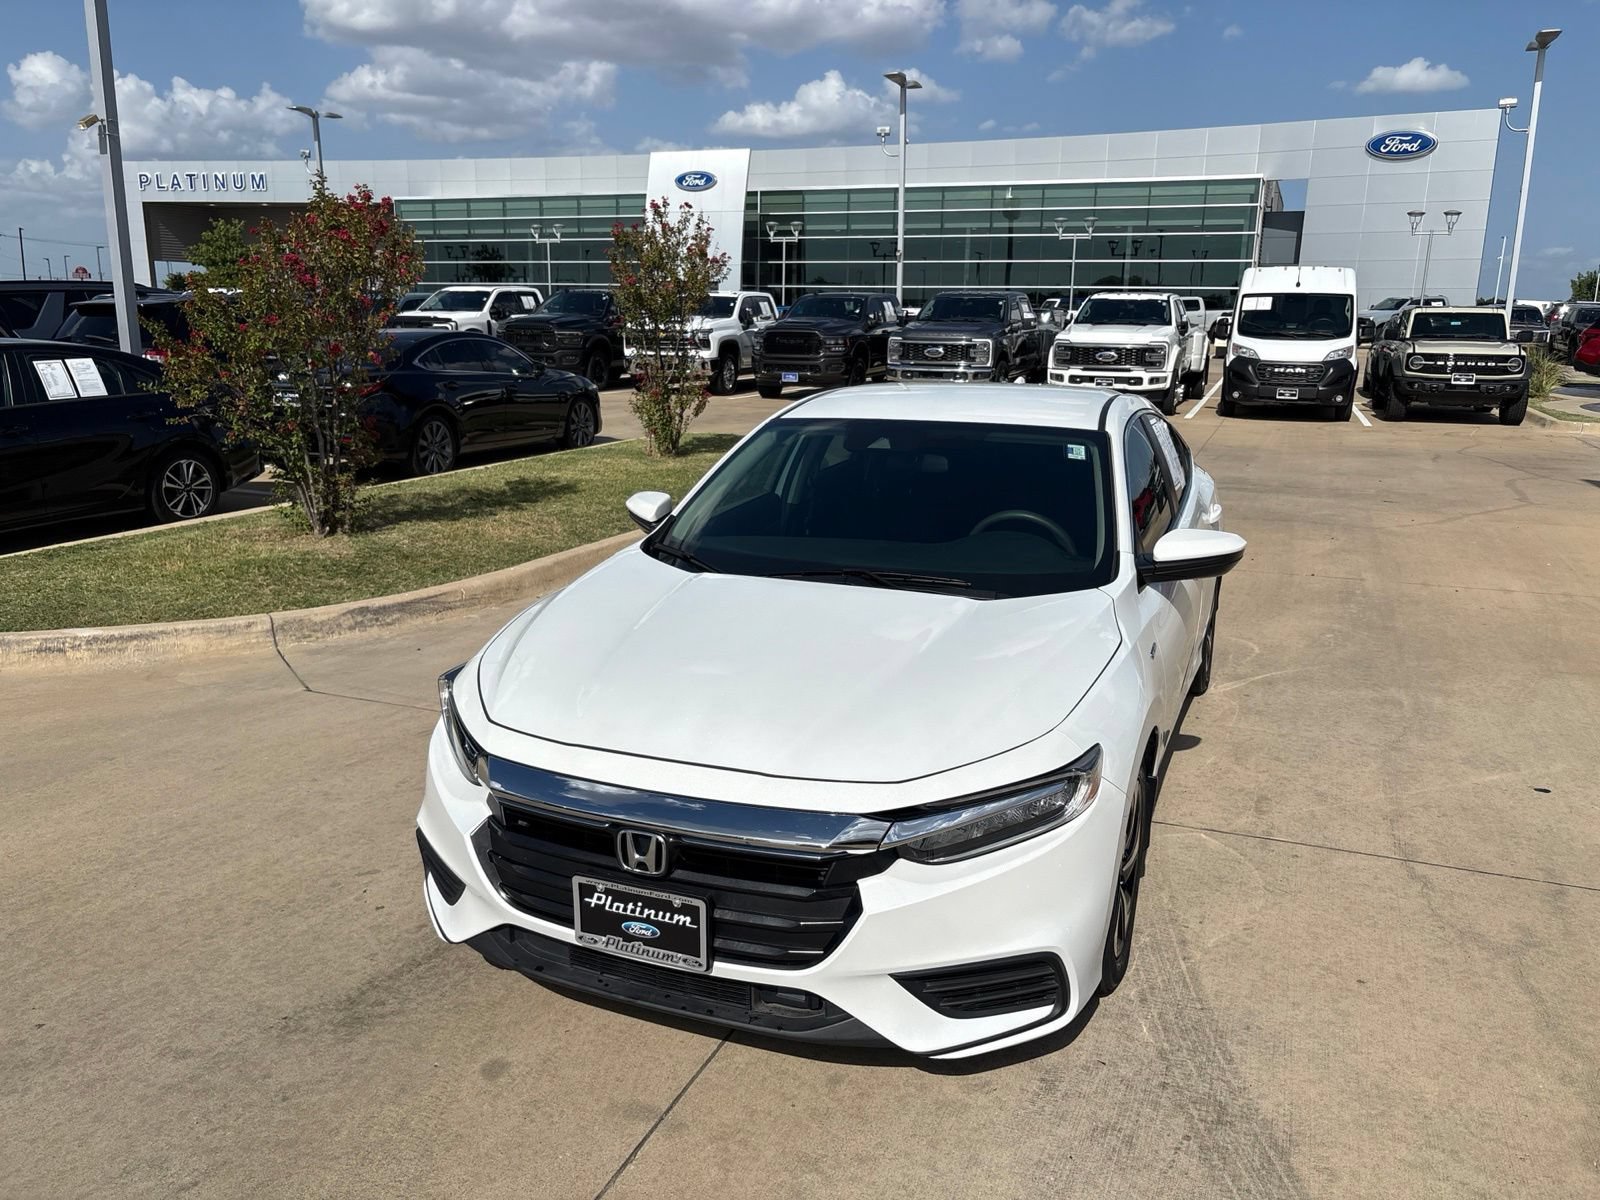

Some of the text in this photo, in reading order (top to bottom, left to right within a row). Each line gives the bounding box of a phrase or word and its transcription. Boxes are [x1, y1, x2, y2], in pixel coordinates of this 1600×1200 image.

[1380, 136, 1422, 153] Ford
[138, 172, 266, 191] PLATINUM
[584, 892, 698, 929] Platinum
[628, 924, 653, 937] Ford
[602, 935, 682, 964] Platinum
